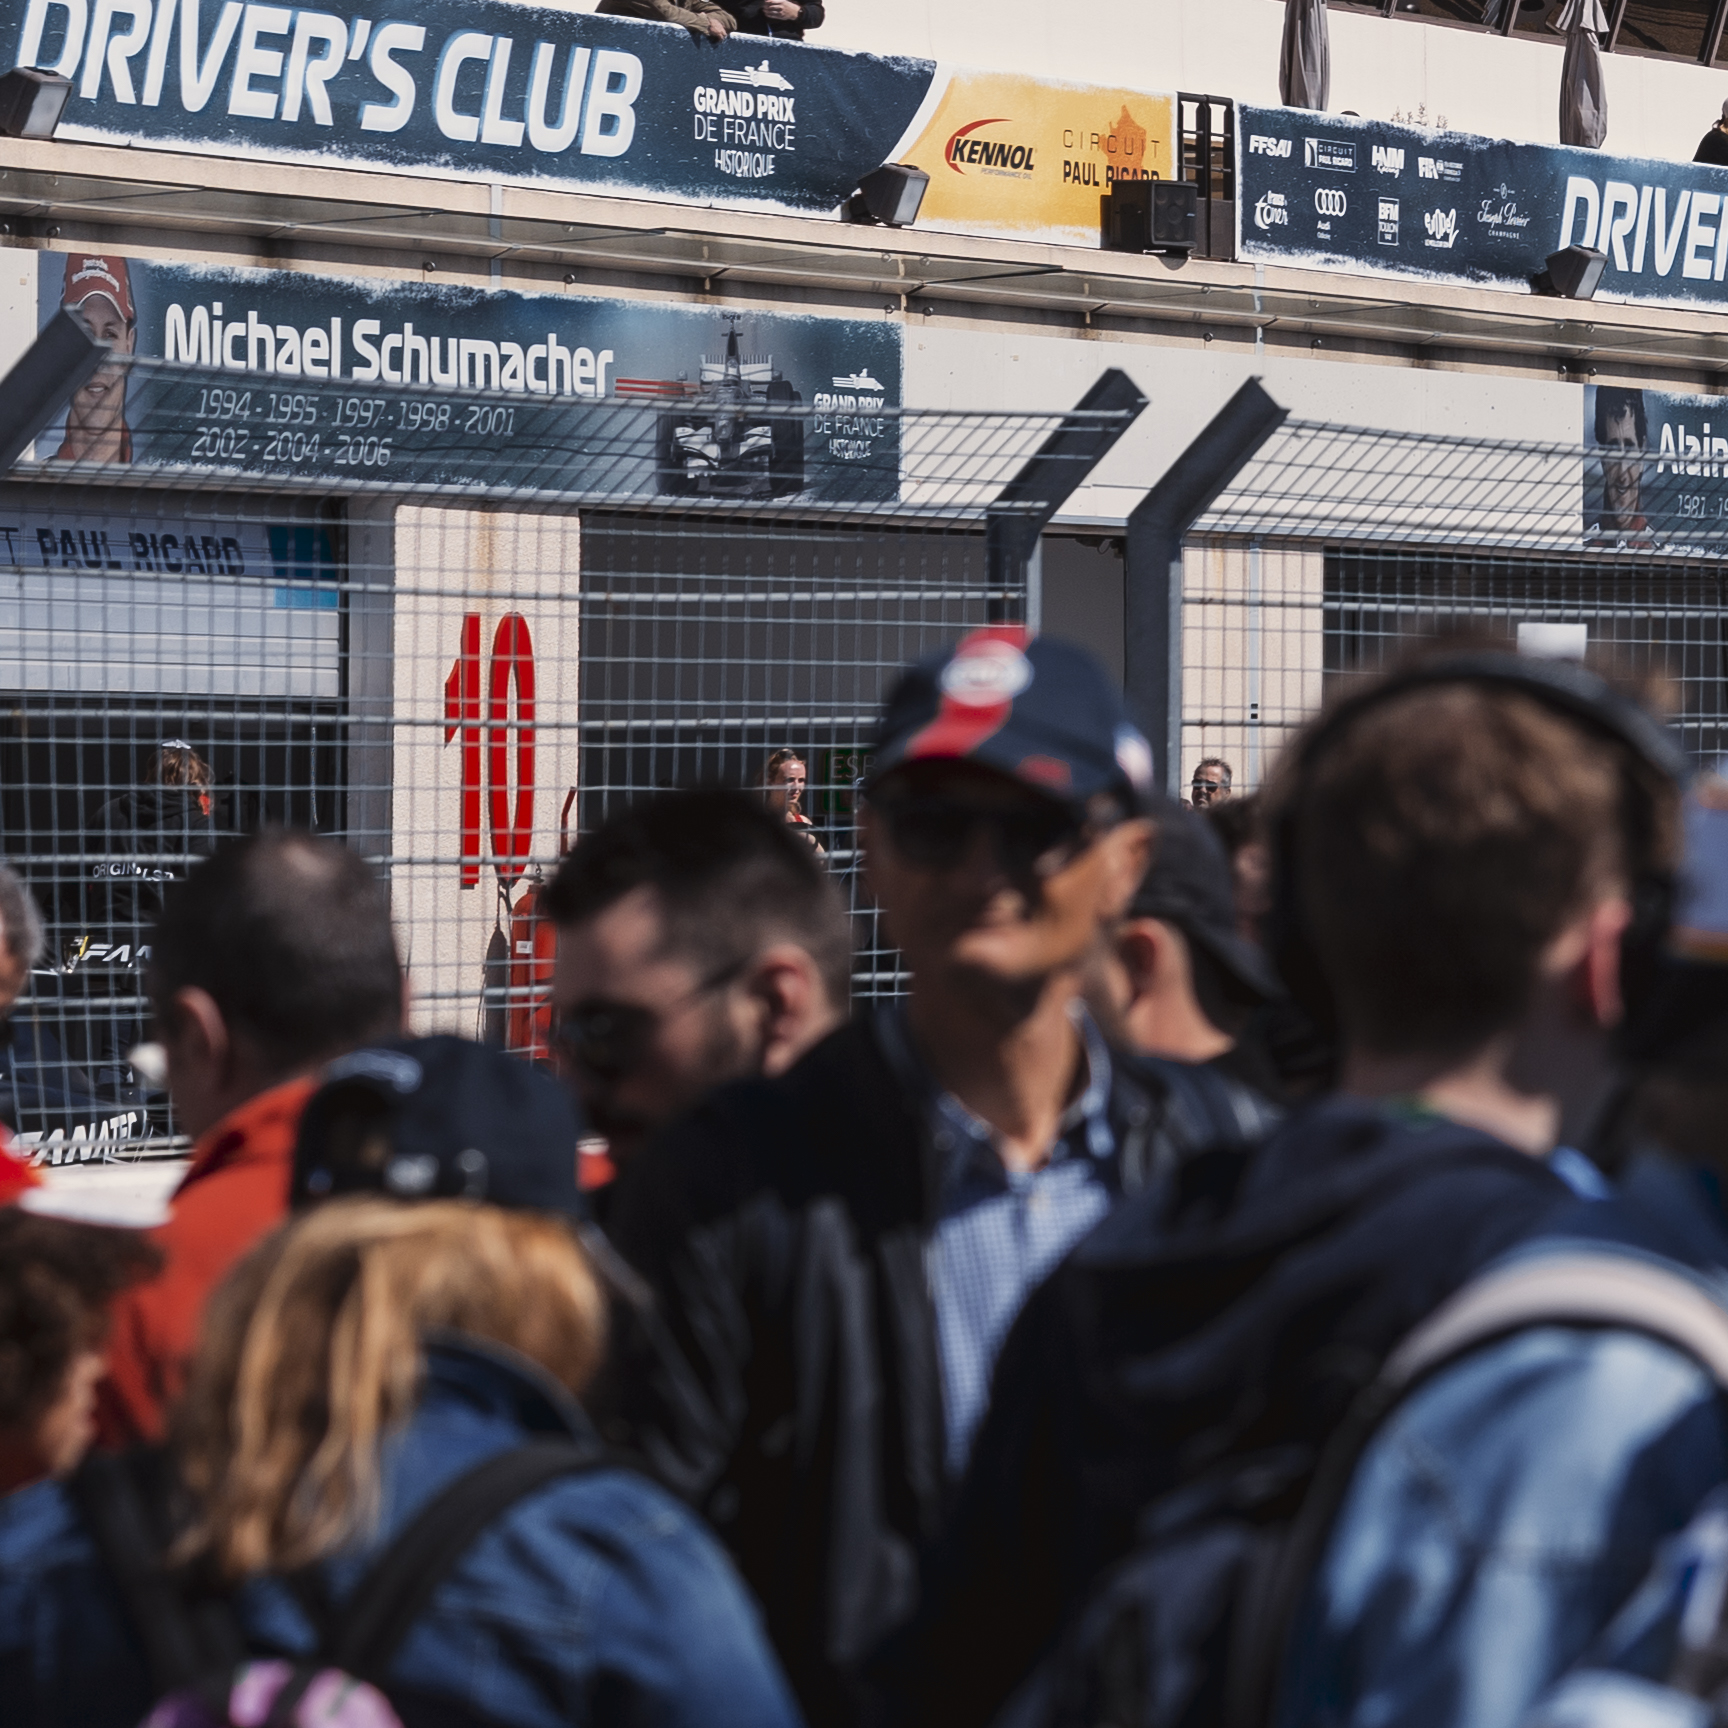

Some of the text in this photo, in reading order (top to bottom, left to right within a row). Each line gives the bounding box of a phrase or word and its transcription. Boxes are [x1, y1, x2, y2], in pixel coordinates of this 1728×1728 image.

[435, 32, 643, 157] CLUB
[693, 85, 796, 123] GRAND PRIX
[694, 115, 796, 151] DE FRANCE
[1063, 129, 1160, 159] CIRCUIT
[1318, 145, 1353, 155] CIRCUIT
[715, 148, 775, 178] HISTORIQUE
[952, 138, 1034, 170] KENNOL
[1063, 160, 1099, 187] PAUL
[1488, 230, 1520, 239] CHAMPAGNE
[164, 301, 614, 398] Michael Schumacher
[195, 388, 515, 436] 1994 1995 1997 1998 2001
[814, 414, 885, 438] DE FRANCE
[191, 427, 392, 466] 2002 2004 2006
[1657, 423, 1728, 479] Alain
[1675, 494, 1706, 520] 1981
[36, 527, 122, 570] PAUL
[128, 532, 244, 576] RICARD
[444, 611, 534, 886] 10
